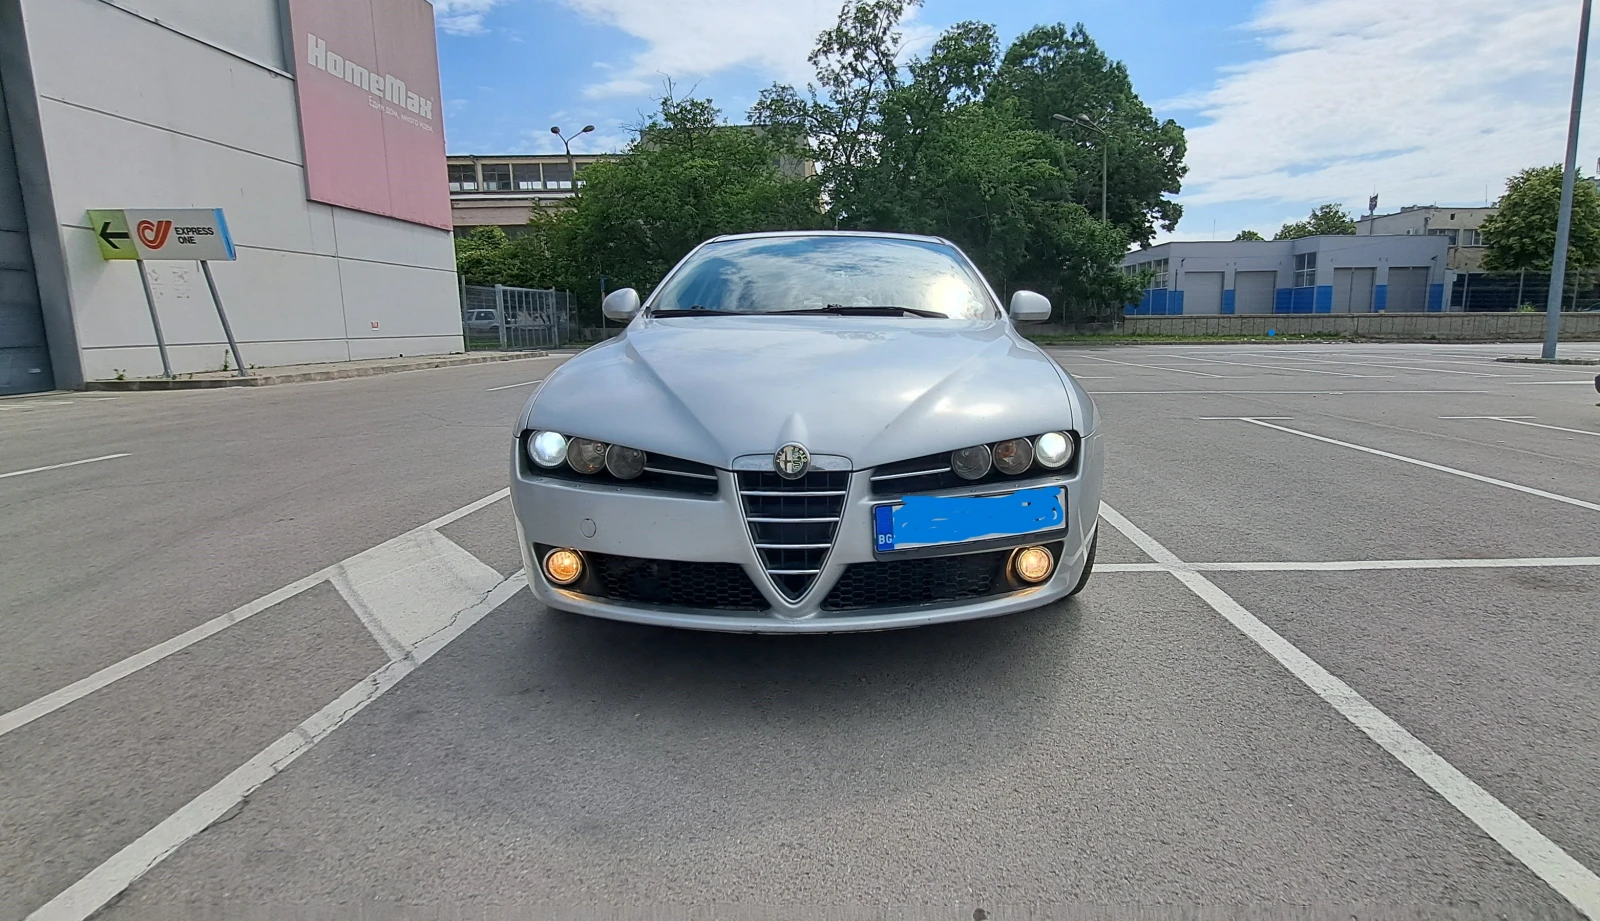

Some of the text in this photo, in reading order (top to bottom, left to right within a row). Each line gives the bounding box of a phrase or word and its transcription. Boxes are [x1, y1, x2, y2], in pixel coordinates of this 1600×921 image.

[307, 32, 432, 120] HomeMax
[174, 226, 215, 236] EXPRESS
[177, 236, 197, 245] ONE
[878, 533, 893, 545] BG
